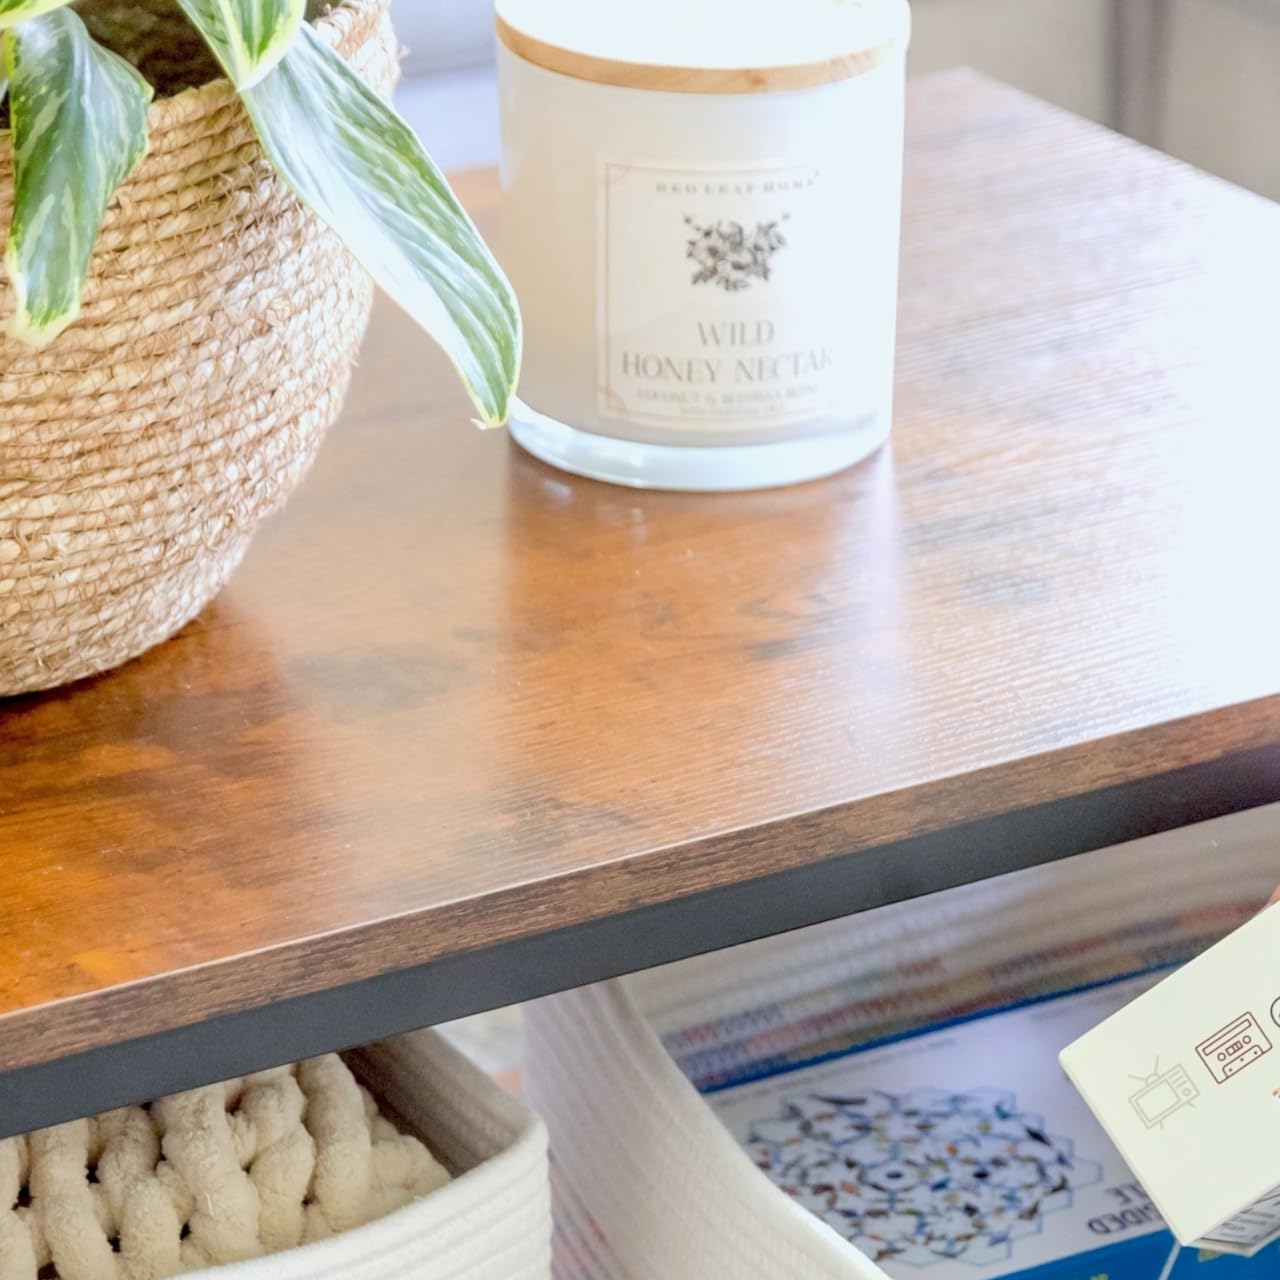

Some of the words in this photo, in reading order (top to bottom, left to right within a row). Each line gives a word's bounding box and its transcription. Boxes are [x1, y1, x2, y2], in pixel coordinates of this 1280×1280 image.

[698, 319, 776, 346] WILD
[621, 351, 722, 384] HONEY
[735, 347, 833, 382] NECTAR
